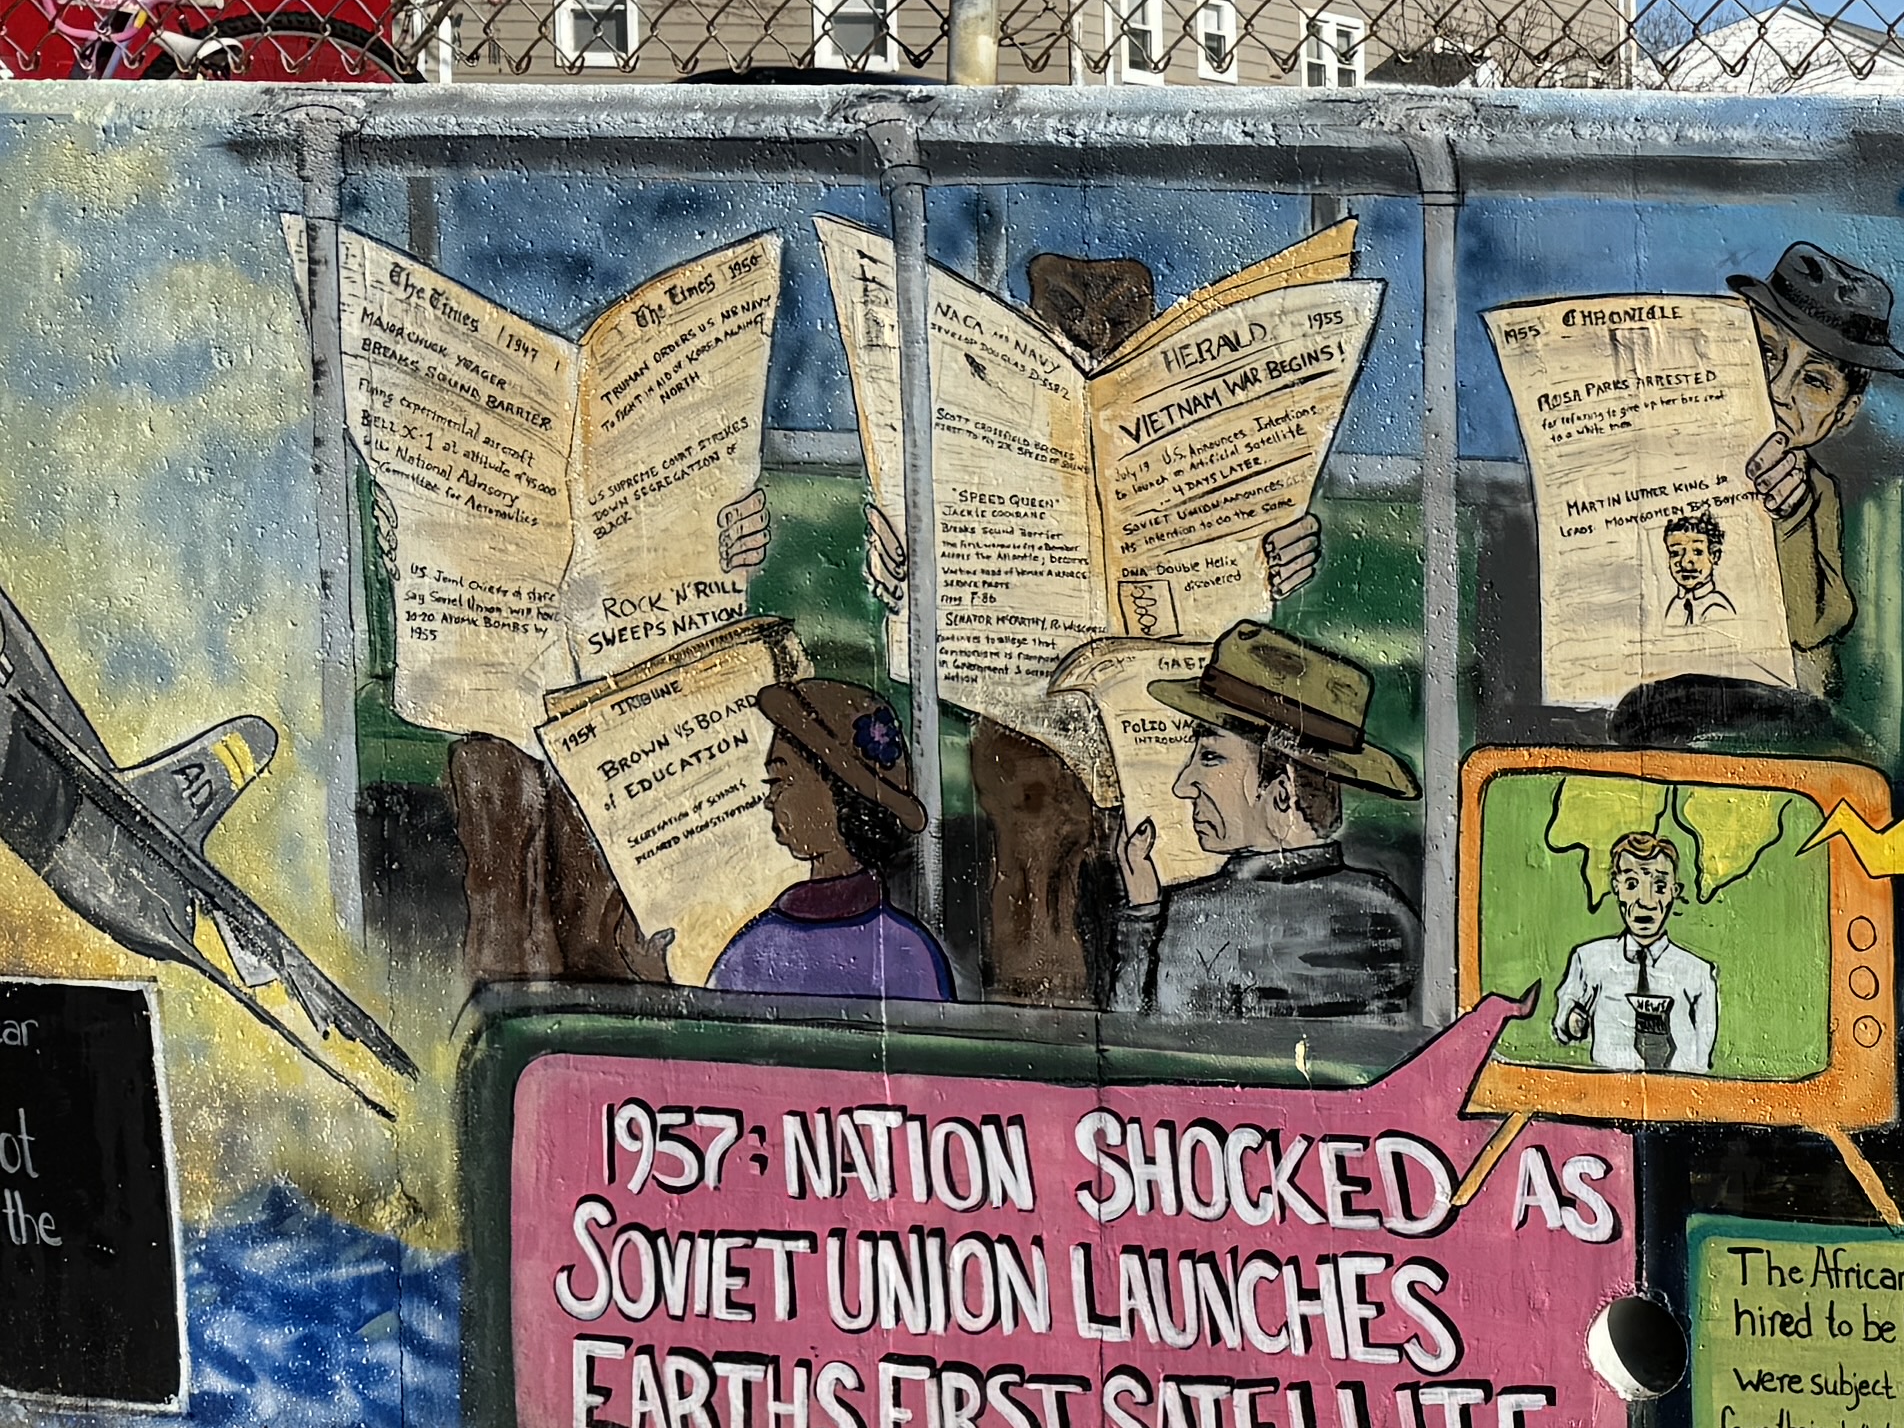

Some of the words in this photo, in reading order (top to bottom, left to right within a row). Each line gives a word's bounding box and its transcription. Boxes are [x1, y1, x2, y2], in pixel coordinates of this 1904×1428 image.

[390, 262, 425, 301] The
[429, 287, 480, 332] Times
[506, 334, 538, 363] 1947
[631, 304, 666, 328] The
[664, 274, 715, 305] Times
[729, 253, 762, 279] 1950
[362, 307, 404, 338] MAJOR
[408, 331, 448, 357] CHUCK
[935, 301, 984, 335] NACA
[1014, 339, 1061, 374] NAVY
[1162, 323, 1270, 372] HERALD
[1307, 311, 1344, 329] 1955
[1504, 324, 1541, 343] 1955
[362, 338, 420, 373] BREAKS
[425, 366, 481, 401] SOUND
[486, 395, 552, 431] BARRIER
[601, 360, 650, 406] TRUMAN
[653, 329, 697, 363] ORDERS
[698, 318, 715, 333] US
[659, 372, 700, 405] NORTH
[1119, 392, 1221, 445] VIETNAM
[1223, 367, 1262, 399] WAR
[1266, 342, 1345, 380] BEGINS!
[1536, 390, 1582, 411] ROSA
[1585, 378, 1630, 399] PARKS
[1636, 371, 1718, 391] ARRESTED
[608, 466, 659, 499] SUPREME
[662, 447, 694, 470] COURT
[699, 417, 749, 451] STRIKES
[1186, 471, 1217, 491] DAYS
[593, 498, 629, 522] DOWN
[634, 451, 720, 502] SEGREGATION
[1567, 495, 1622, 517] MARTIN
[1625, 486, 1668, 506] LUTHER
[1674, 479, 1710, 493] KING
[593, 512, 632, 539] BLACK
[1122, 568, 1148, 577] DNA
[1156, 562, 1200, 575] Double
[1205, 559, 1238, 569] Helix
[602, 596, 668, 622] ROCK
[695, 580, 743, 601] ROLL
[588, 624, 665, 655] SWEEPS
[673, 604, 743, 636] NATION
[611, 680, 683, 716] TRIBUNE
[561, 725, 597, 753] 1954
[598, 734, 669, 781] BROWN
[693, 694, 759, 730] BOARD
[1123, 720, 1167, 733] POLIO
[623, 729, 749, 799] EDUCATION
[785, 1103, 1037, 1214] NATION
[1075, 1109, 1459, 1237] SHOCKED
[1511, 1144, 1622, 1243] AS
[2, 1188, 62, 1246] the
[556, 1195, 822, 1323] SOVIET
[827, 1227, 1052, 1336] UNION
[1069, 1240, 1465, 1376] LAUNCHES
[1727, 1247, 1804, 1288] The
